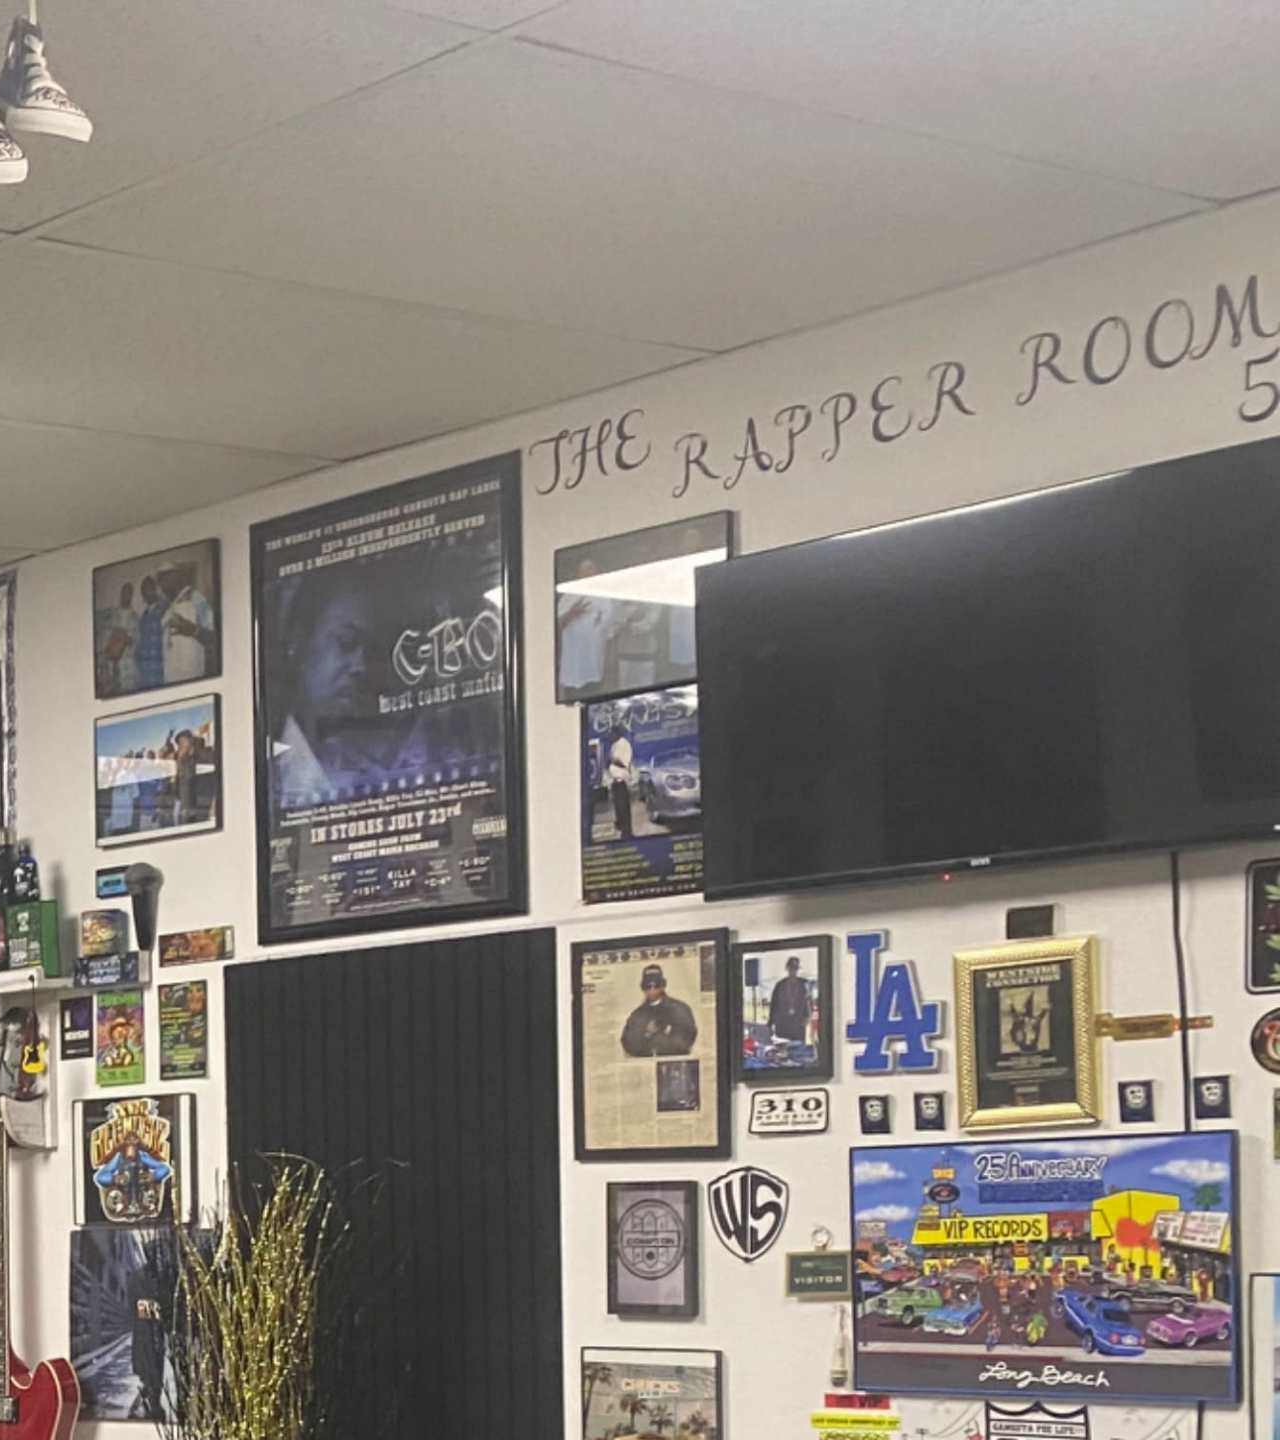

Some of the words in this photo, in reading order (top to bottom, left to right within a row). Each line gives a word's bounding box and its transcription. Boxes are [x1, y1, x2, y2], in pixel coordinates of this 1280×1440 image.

[529, 409, 649, 494] THE
[673, 361, 975, 497] RAPPER
[1016, 275, 1280, 405] ROOM
[392, 610, 502, 685] C-BO
[311, 827, 327, 844] IN
[329, 818, 384, 841] STORES
[387, 810, 424, 832] JULY
[428, 802, 462, 825] 23rd
[986, 965, 1061, 980] WESTSIDE
[846, 932, 940, 1072] LA
[757, 1096, 824, 1114] 310
[975, 1153, 1007, 1183] 25
[943, 1217, 969, 1238] VIP
[973, 1215, 1044, 1239] RECORDS
[793, 1274, 843, 1285] VISITOR
[978, 1361, 1040, 1390] Long
[1040, 1363, 1111, 1388] Beach
